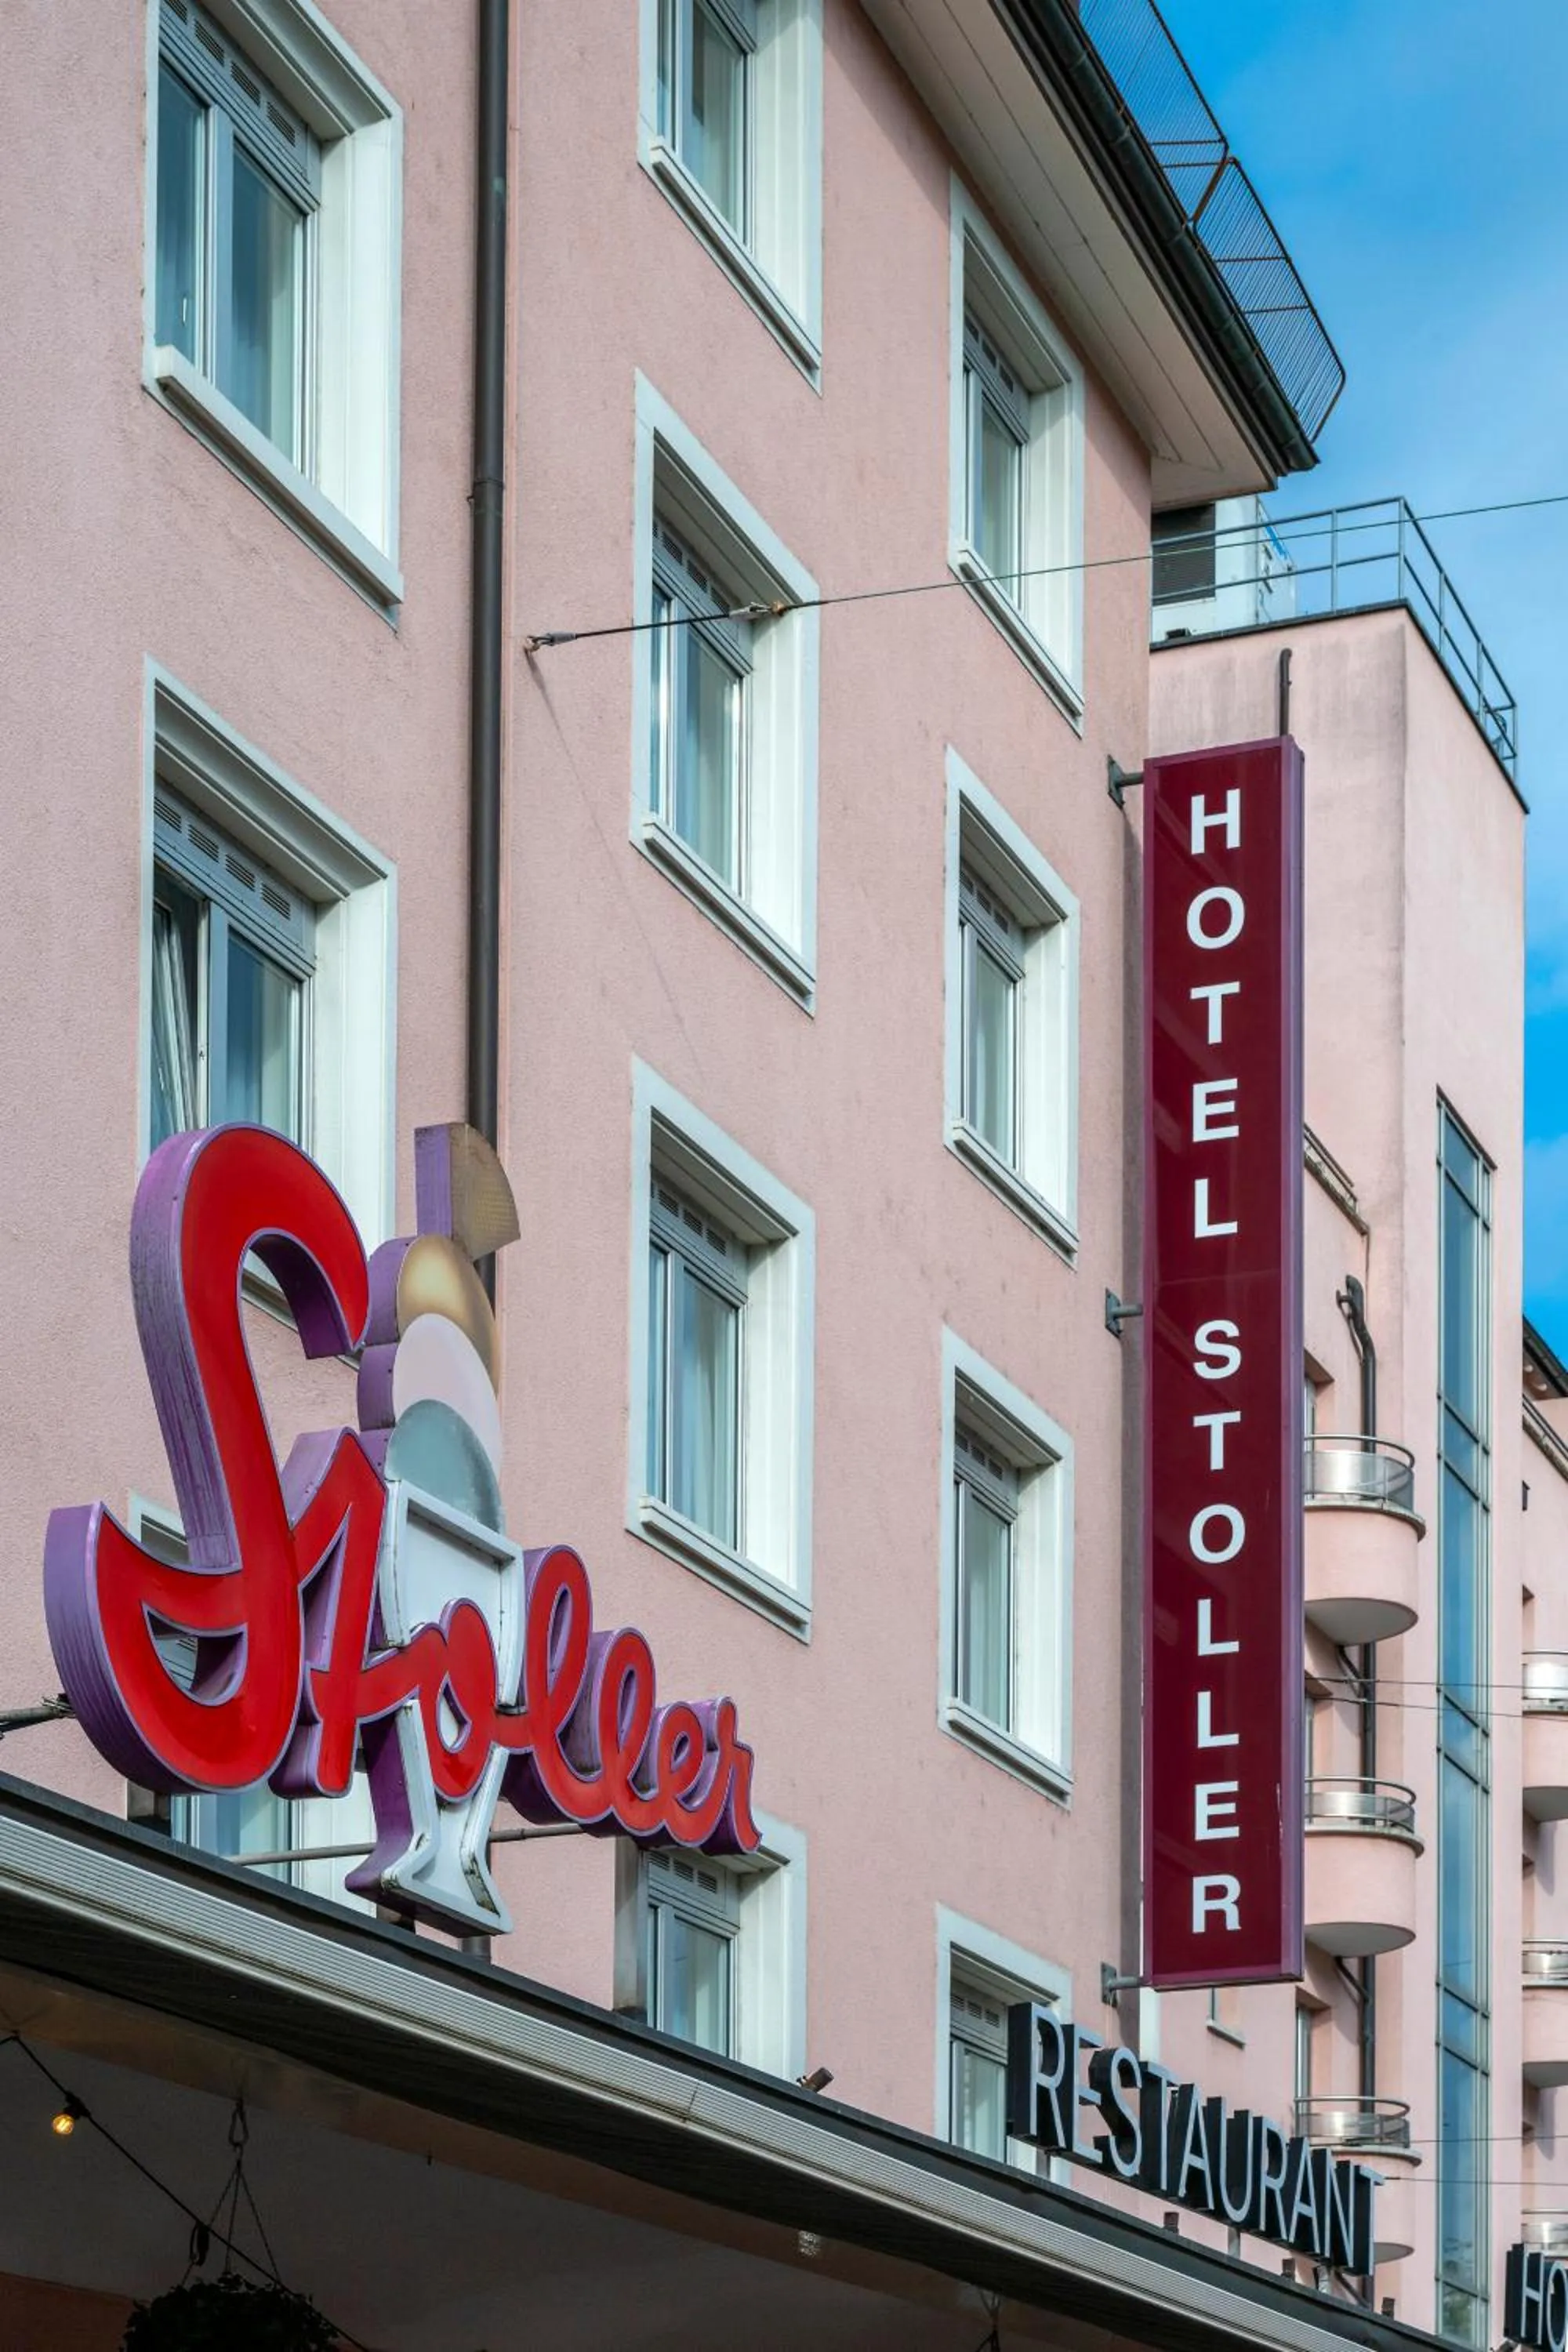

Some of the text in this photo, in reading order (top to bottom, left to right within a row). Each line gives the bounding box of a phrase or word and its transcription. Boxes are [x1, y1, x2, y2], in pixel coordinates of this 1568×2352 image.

[45, 1122, 764, 1855] Stoller
[1185, 788, 1246, 1934] HOTEL STOLLER
[1010, 2002, 1385, 2275] RESTAURANT
